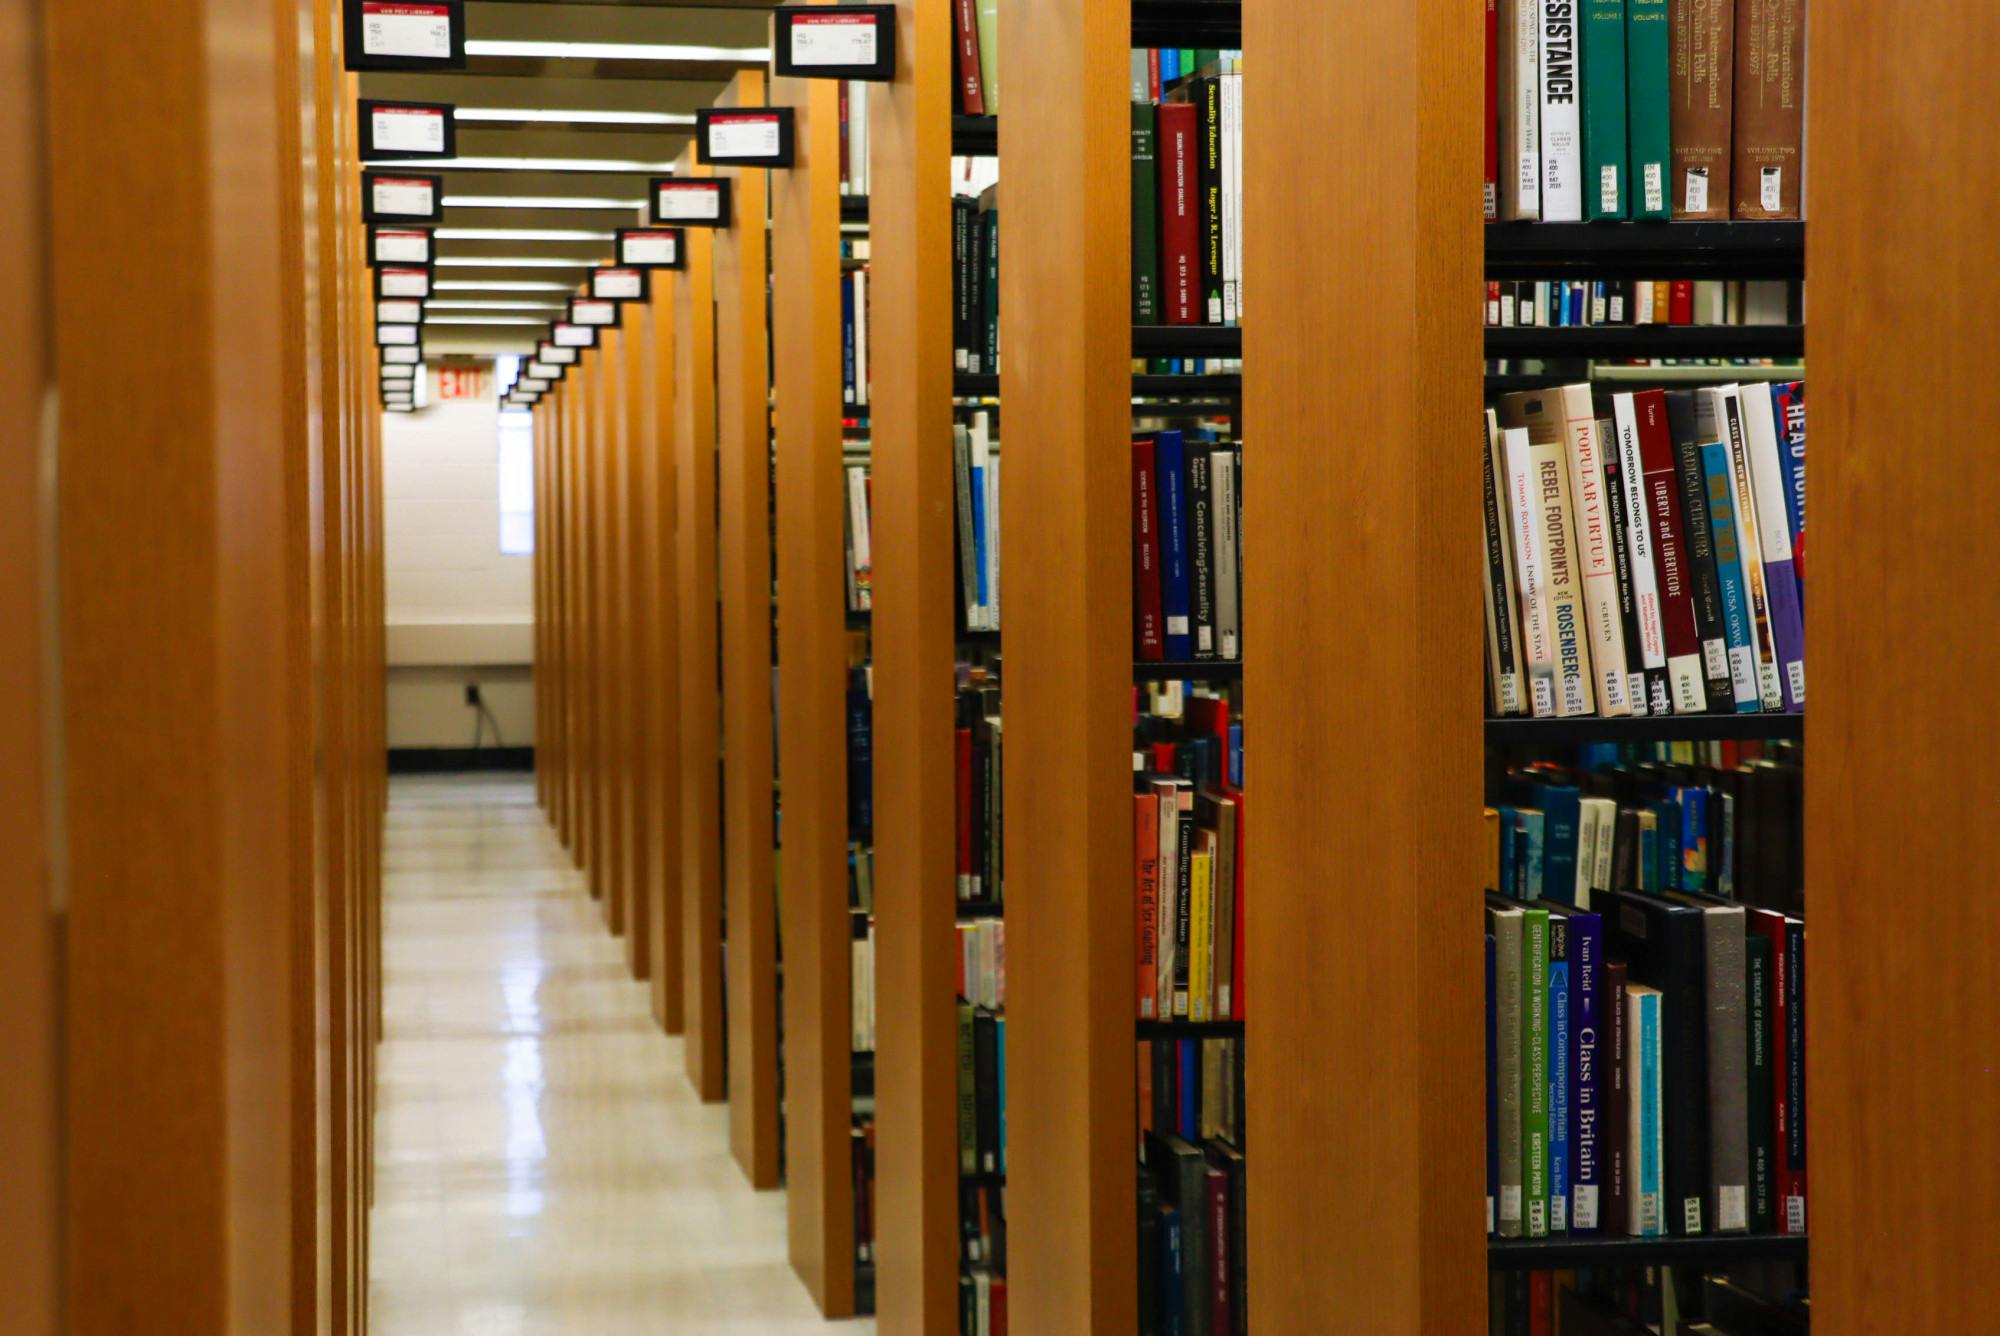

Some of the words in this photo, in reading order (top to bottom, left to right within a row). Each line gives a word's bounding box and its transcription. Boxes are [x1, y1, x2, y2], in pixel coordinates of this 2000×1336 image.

[1691, 0, 1707, 51] Opinion
[1546, 0, 1573, 105] SISTANCE
[1708, 27, 1721, 109] International
[1766, 53, 1779, 83] Polls
[1781, 26, 1795, 109] International
[1694, 53, 1706, 84] Polls
[1207, 83, 1217, 124] Sexuality
[1209, 125, 1218, 170] Education
[1209, 186, 1218, 214] Roger
[1210, 214, 1218, 223] J.
[1210, 224, 1218, 234] R.
[1210, 235, 1219, 276] Levesque
[1647, 404, 1656, 427] Turner
[1730, 417, 1738, 439] CLASS
[1785, 403, 1805, 458] HEAD
[1733, 440, 1740, 449] IN
[1191, 457, 1200, 489] Gagnon
[1577, 425, 1598, 503] POPULAR
[1681, 441, 1701, 497] RADICAL
[1736, 465, 1744, 480] NEW
[1517, 473, 1527, 508] TOMMY
[1540, 460, 1557, 503] REBEL
[1612, 495, 1622, 523] RADICAL
[1630, 487, 1643, 528] BELONGS
[1654, 480, 1671, 517] LIBERTY
[1487, 500, 1498, 537] RADICAL
[1661, 520, 1673, 540] and
[1690, 499, 1710, 558] CULTURE
[1520, 510, 1534, 561] ROBINSON
[1545, 506, 1570, 586] FOOTPRINTS
[1587, 504, 1605, 568] VIRTUE
[1615, 524, 1624, 545] RIGHT
[1636, 530, 1644, 542] TO
[1490, 540, 1500, 566] WAYS
[1618, 554, 1628, 581] BRITAIN
[1527, 565, 1538, 596] ENEMY
[1662, 542, 1681, 599] LIBERTICIDE
[1530, 598, 1539, 611] OF
[1621, 582, 1630, 596] Alan
[1726, 579, 1738, 612] MUSA
[1622, 596, 1632, 614] Sykes
[1532, 614, 1541, 632] THE
[1600, 601, 1612, 643] SCRIVEN
[1534, 633, 1544, 662] STATE
[1180, 824, 1190, 873] Counseling
[1143, 859, 1155, 875] The
[1143, 877, 1155, 892] Art
[1180, 888, 1189, 917] Sexual
[1140, 925, 1155, 965] Coaching
[1179, 918, 1188, 943] Issues
[1556, 924, 1567, 958] palgrave
[1581, 935, 1592, 962] Ivan
[1753, 957, 1762, 969] THE
[1581, 965, 1593, 992] Reid
[1753, 971, 1762, 1007] STRUCTURE
[1557, 991, 1568, 1019] Class
[1754, 1009, 1762, 1019] OF
[1791, 1001, 1799, 1026] SOCIAL
[1532, 995, 1542, 1062] WORKING-CLASS
[1557, 1020, 1568, 1030] in
[1579, 1026, 1596, 1082] Class
[1754, 1019, 1763, 1067] DISADVANTAGE
[1555, 1031, 1568, 1105] Contemporary
[1532, 1063, 1542, 1115] PERSPECTIVE
[1549, 1082, 1557, 1112] Second
[1580, 1086, 1595, 1104] in
[1791, 1079, 1799, 1118] EDUCATION
[1549, 1113, 1557, 1142] Edition
[1557, 1106, 1568, 1142] Britain
[1531, 1132, 1542, 1170] KIRSTEEN
[1580, 1108, 1596, 1181] Britain
[1553, 1156, 1563, 1176] Ken
[1756, 1158, 1764, 1171] 400
[1531, 1171, 1542, 1196] PATON
